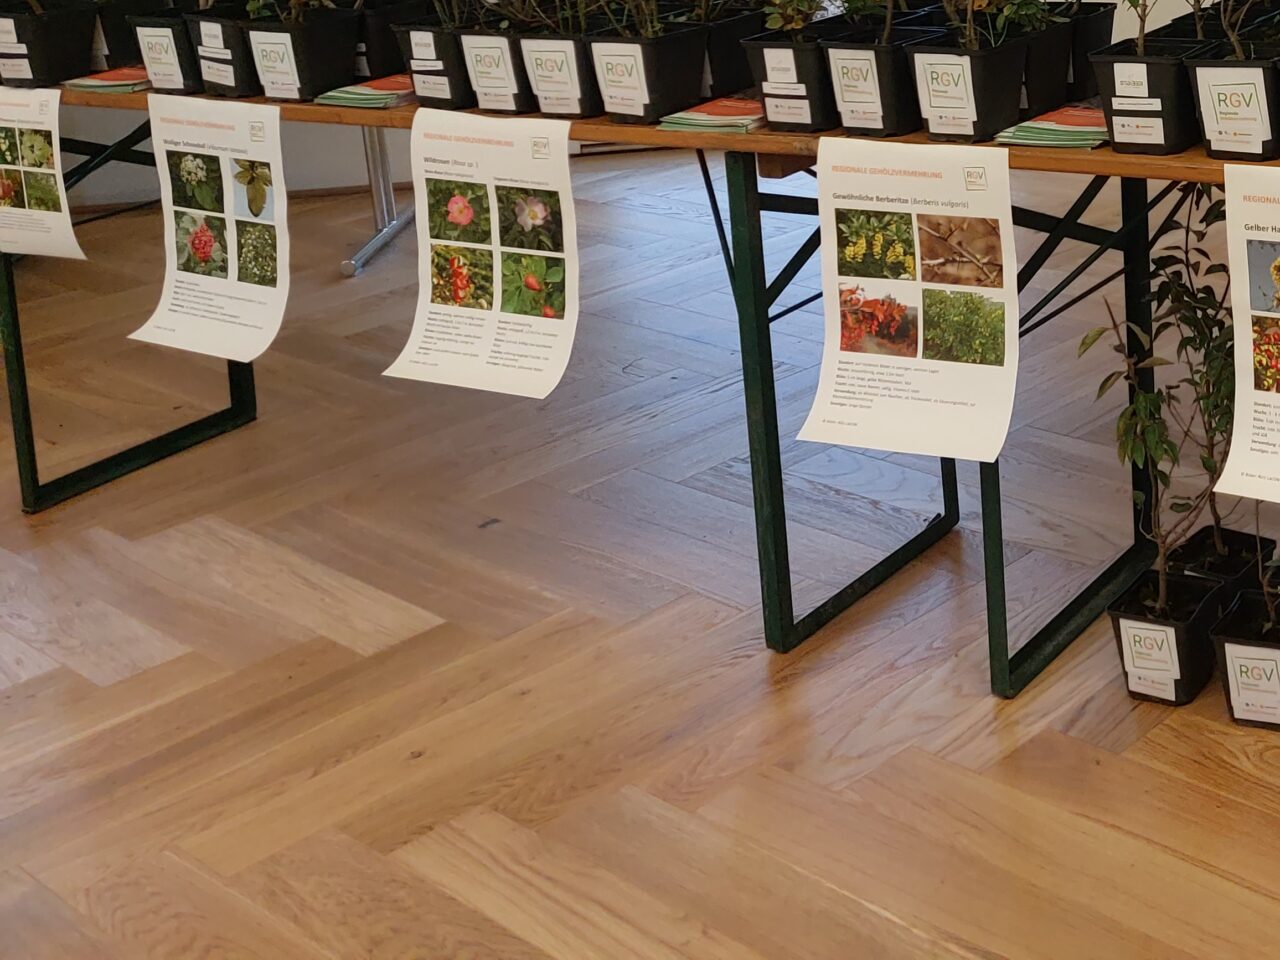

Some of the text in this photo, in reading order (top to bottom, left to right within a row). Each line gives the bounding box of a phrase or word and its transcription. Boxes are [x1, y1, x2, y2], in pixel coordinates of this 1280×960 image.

[147, 42, 169, 56] RGV
[262, 49, 285, 64] RGV
[475, 54, 500, 69] RGV
[535, 57, 564, 73] RGV
[605, 62, 634, 77] RGV
[841, 66, 869, 83] RGV
[930, 71, 961, 87] RGV
[1218, 92, 1253, 108] RGV
[967, 171, 984, 180] RGV
[832, 193, 874, 202] Gewöhnliche
[1244, 224, 1269, 233] Gelber
[1134, 634, 1165, 652] RGV
[1239, 665, 1274, 682] RGV
